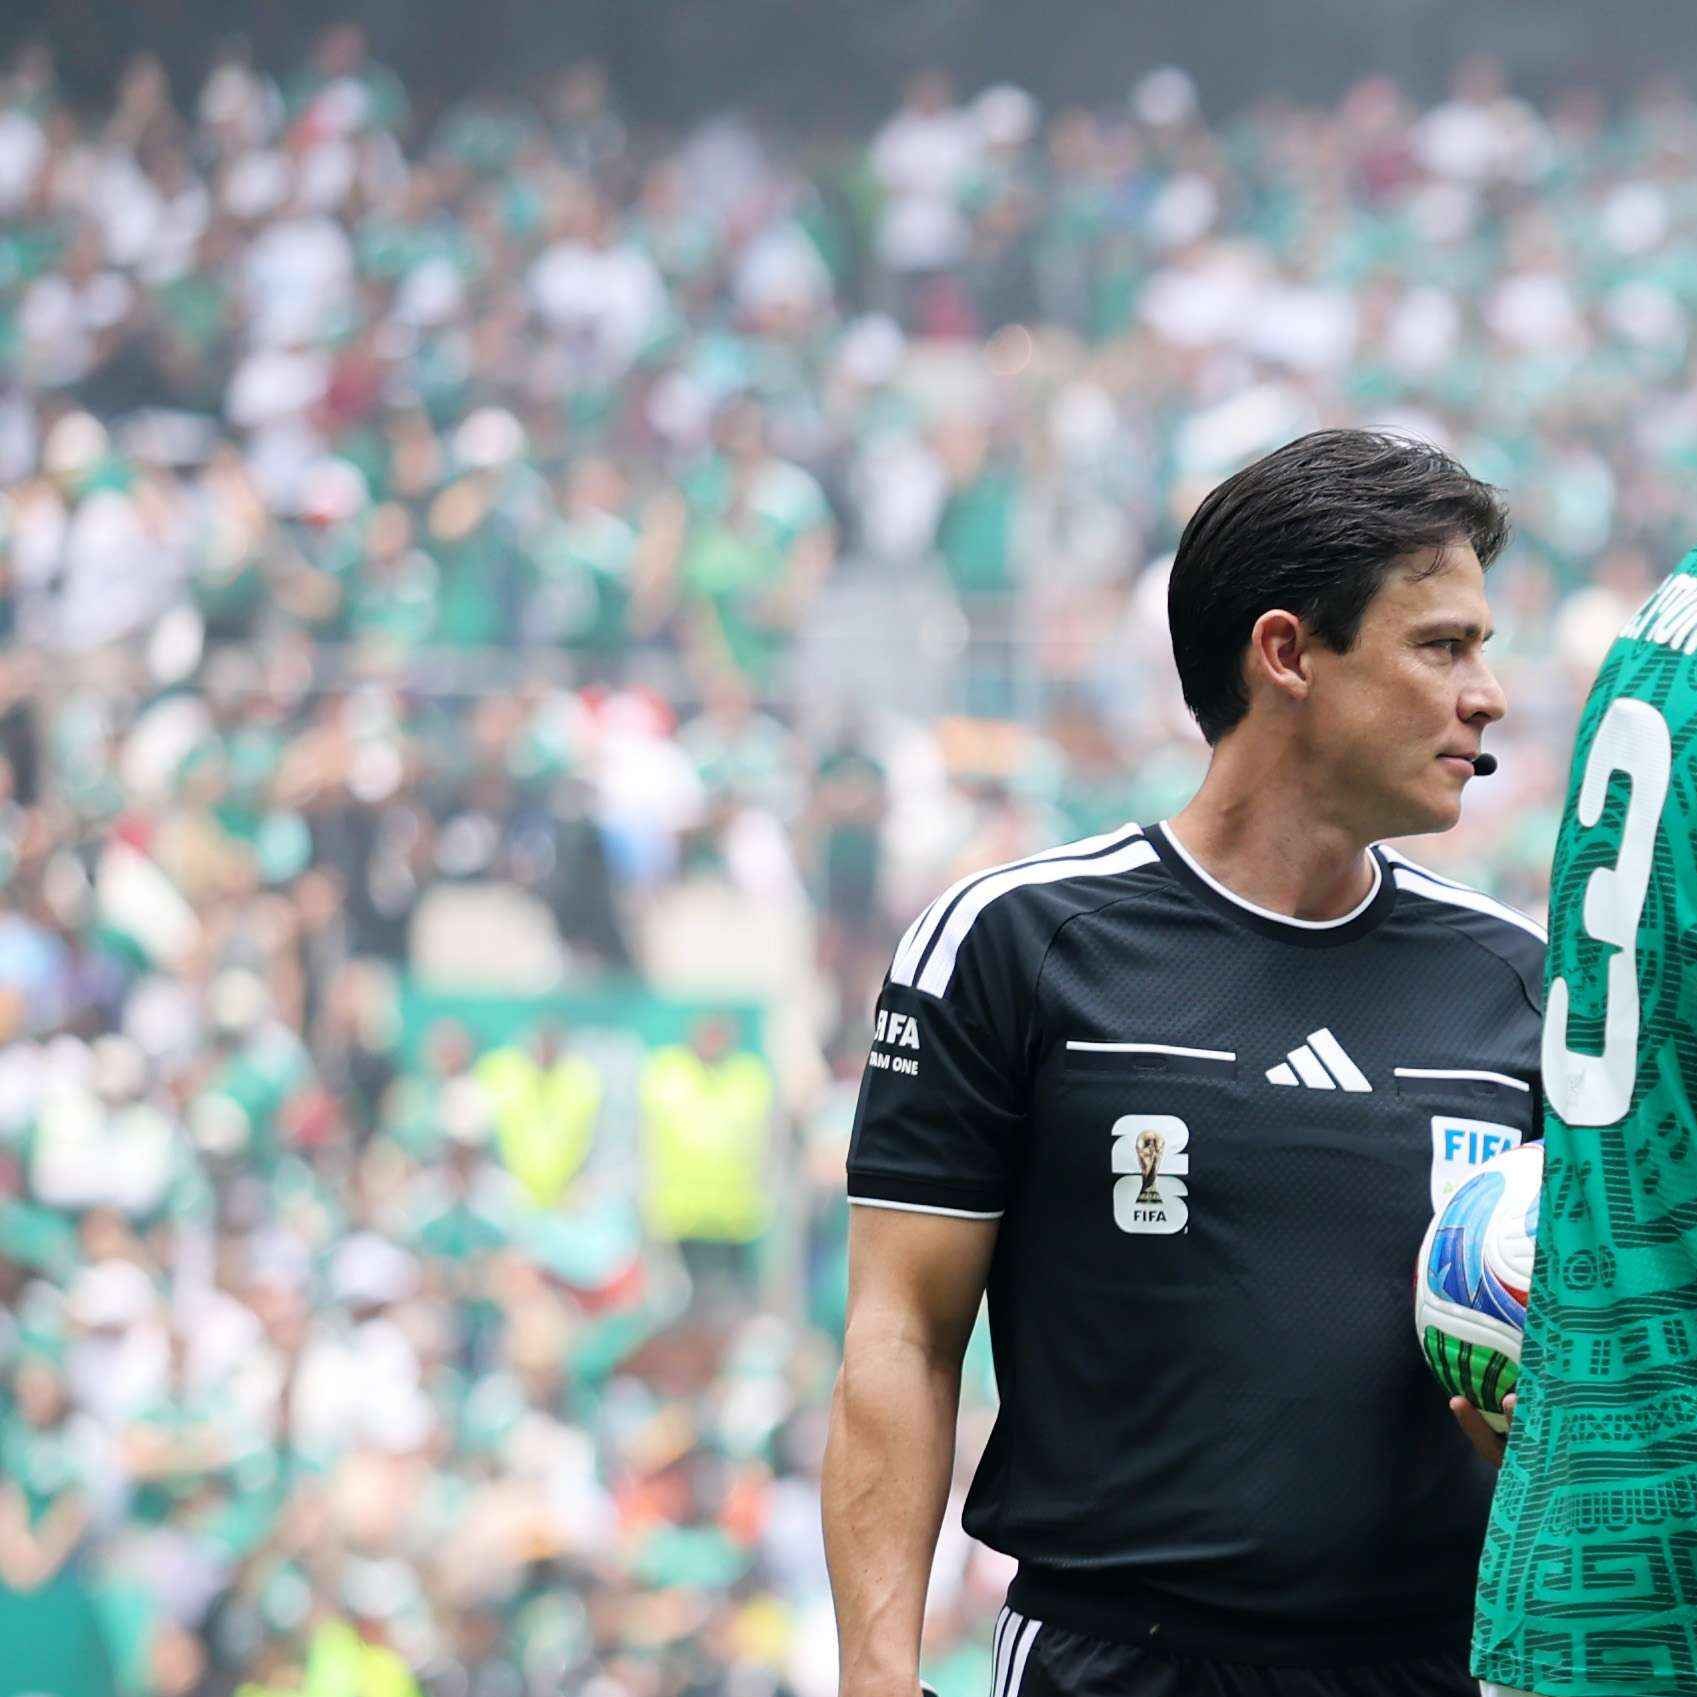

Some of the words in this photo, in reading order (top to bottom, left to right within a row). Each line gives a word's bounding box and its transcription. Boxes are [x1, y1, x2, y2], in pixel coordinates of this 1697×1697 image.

[1541, 697, 1671, 1126] 3
[869, 1051, 890, 1069] AM
[892, 1057, 919, 1075] ONE
[1133, 1210, 1167, 1222] FIFA
